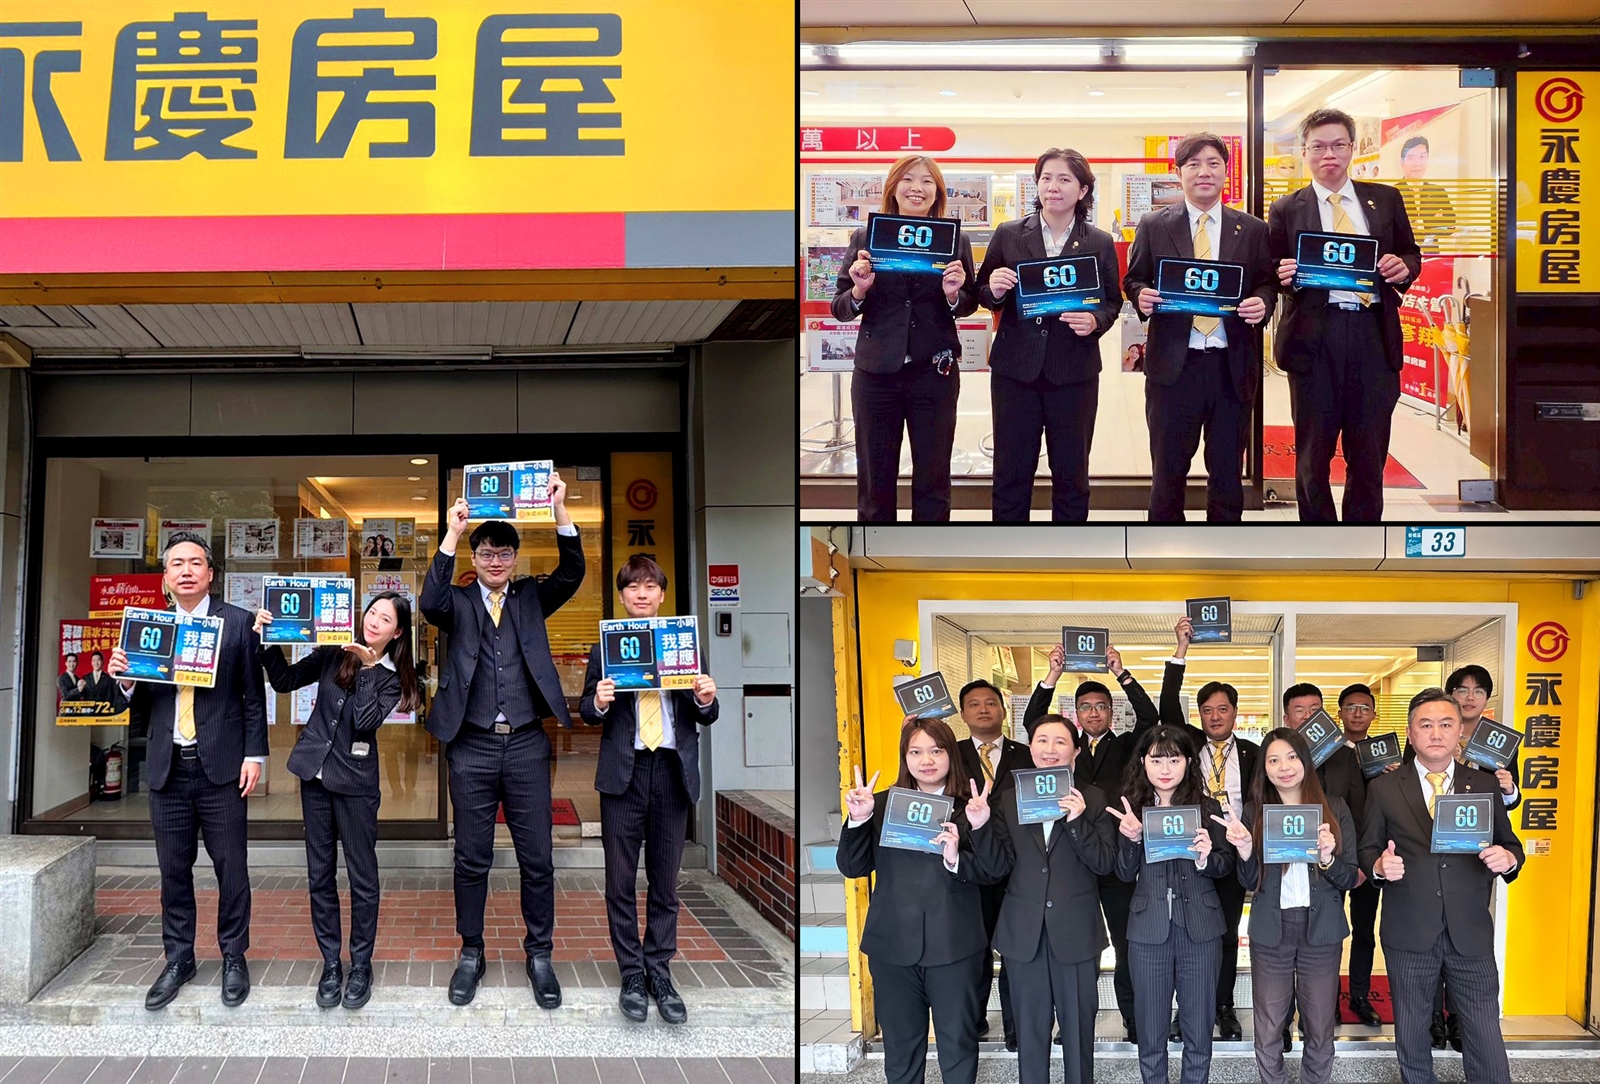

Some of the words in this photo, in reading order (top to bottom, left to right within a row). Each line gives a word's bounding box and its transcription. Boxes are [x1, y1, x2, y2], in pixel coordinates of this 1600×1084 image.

[1540, 128, 1581, 284] 永慶房屋
[898, 225, 933, 248] 60
[1322, 241, 1356, 264] 60
[1043, 264, 1077, 288] 60
[1184, 267, 1220, 291] 60
[480, 475, 499, 493] 60
[520, 472, 548, 486] 我要
[1431, 531, 1456, 552] 33
[265, 578, 287, 587] Earth
[290, 580, 310, 588] Hour
[710, 575, 737, 584] 中保科技
[321, 593, 349, 608] 我要
[711, 588, 738, 597] SECOM
[281, 592, 300, 614] 60
[126, 609, 149, 620] Earth
[153, 613, 174, 623] Hour
[320, 608, 349, 624] 響應
[1201, 605, 1218, 622] 60
[602, 622, 625, 632] Earth
[627, 621, 648, 630] Hour
[140, 626, 162, 650] 60
[183, 630, 215, 648] 我要
[661, 632, 694, 650] 我要
[1077, 635, 1095, 651] 60
[181, 646, 214, 664] 響應
[620, 636, 640, 660] 60
[662, 649, 695, 667] 響應
[914, 684, 935, 704] 60
[1305, 722, 1326, 742] 60
[1486, 730, 1507, 749] 60
[1370, 740, 1388, 757] 60
[1521, 673, 1562, 830] 永慶房屋
[1034, 774, 1057, 795] 60
[907, 801, 933, 824] 60
[1455, 805, 1478, 827] 60
[1162, 814, 1185, 836] 60
[1282, 815, 1305, 836] 60
